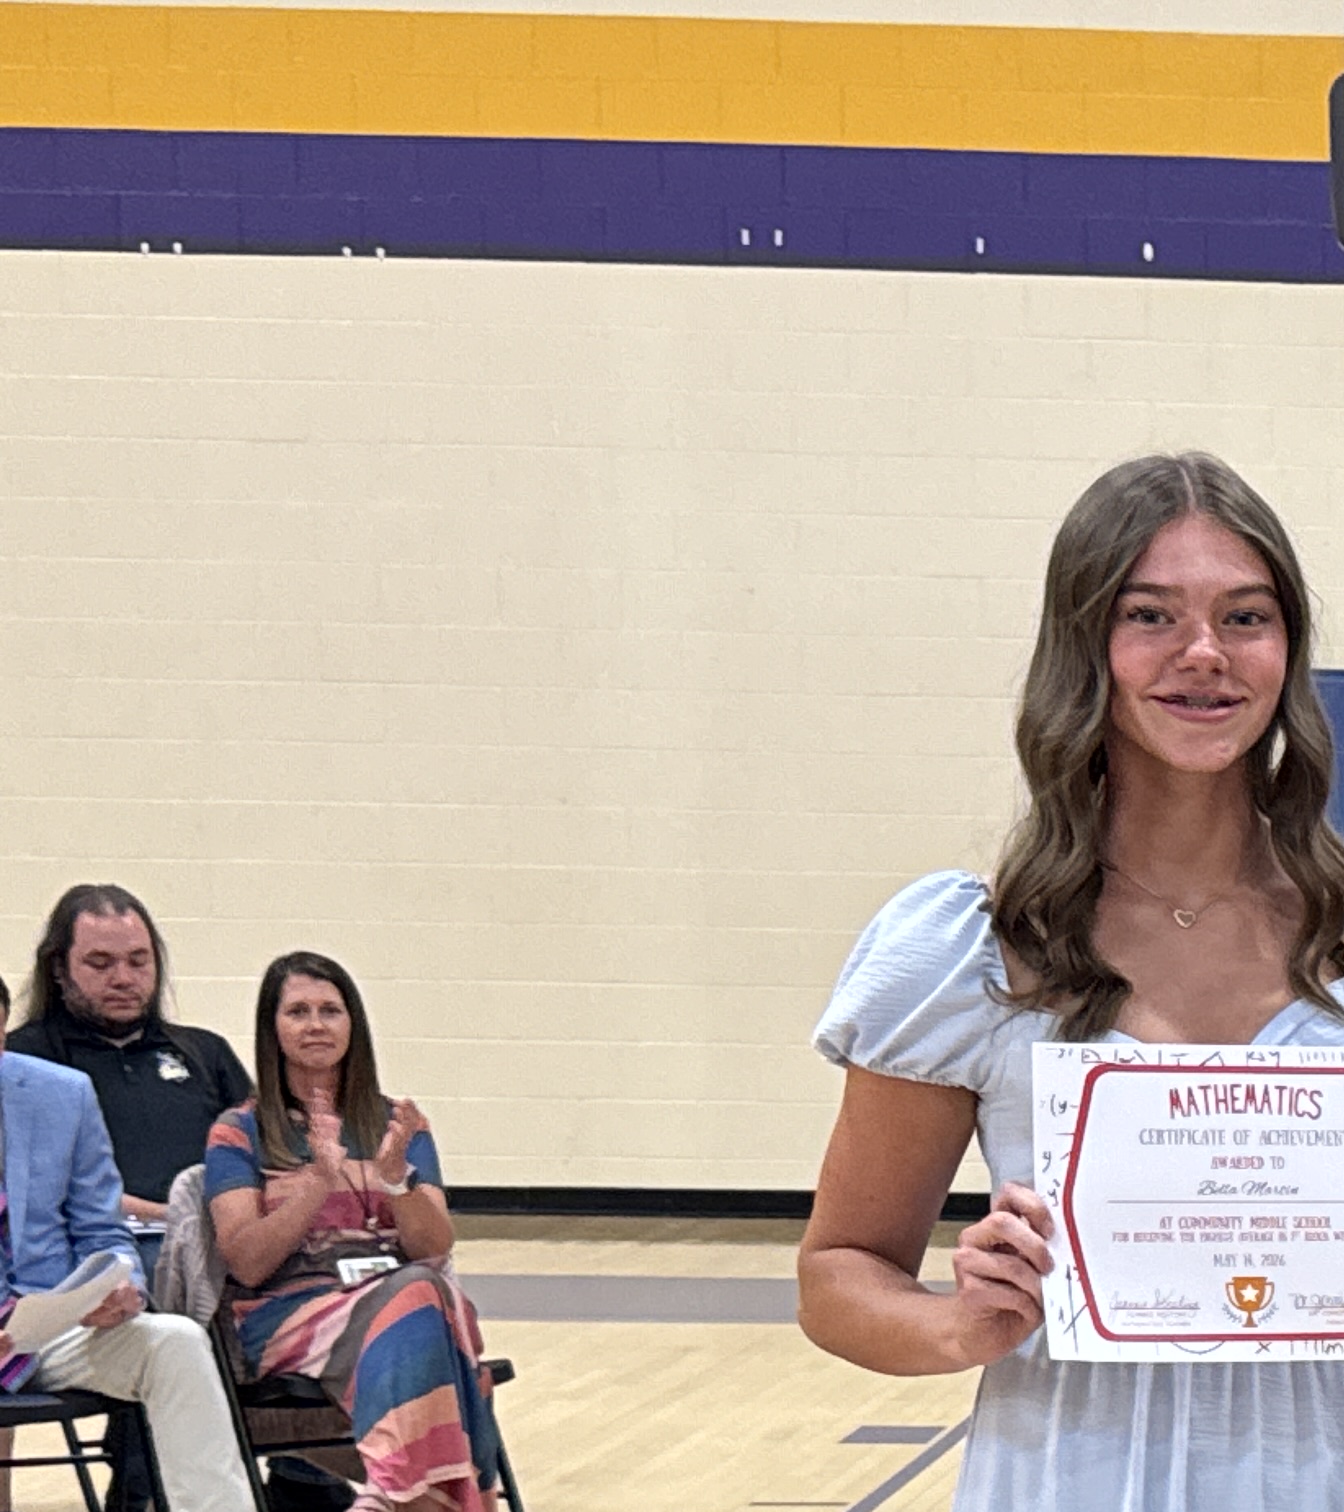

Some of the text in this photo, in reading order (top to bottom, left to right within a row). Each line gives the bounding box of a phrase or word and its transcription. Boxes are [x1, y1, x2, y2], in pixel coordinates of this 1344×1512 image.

[1169, 1083, 1324, 1120] MATHEMATICS
[1138, 1128, 1226, 1146] CERTIFICATE
[1233, 1129, 1250, 1146] OF
[1269, 1156, 1285, 1170] TO
